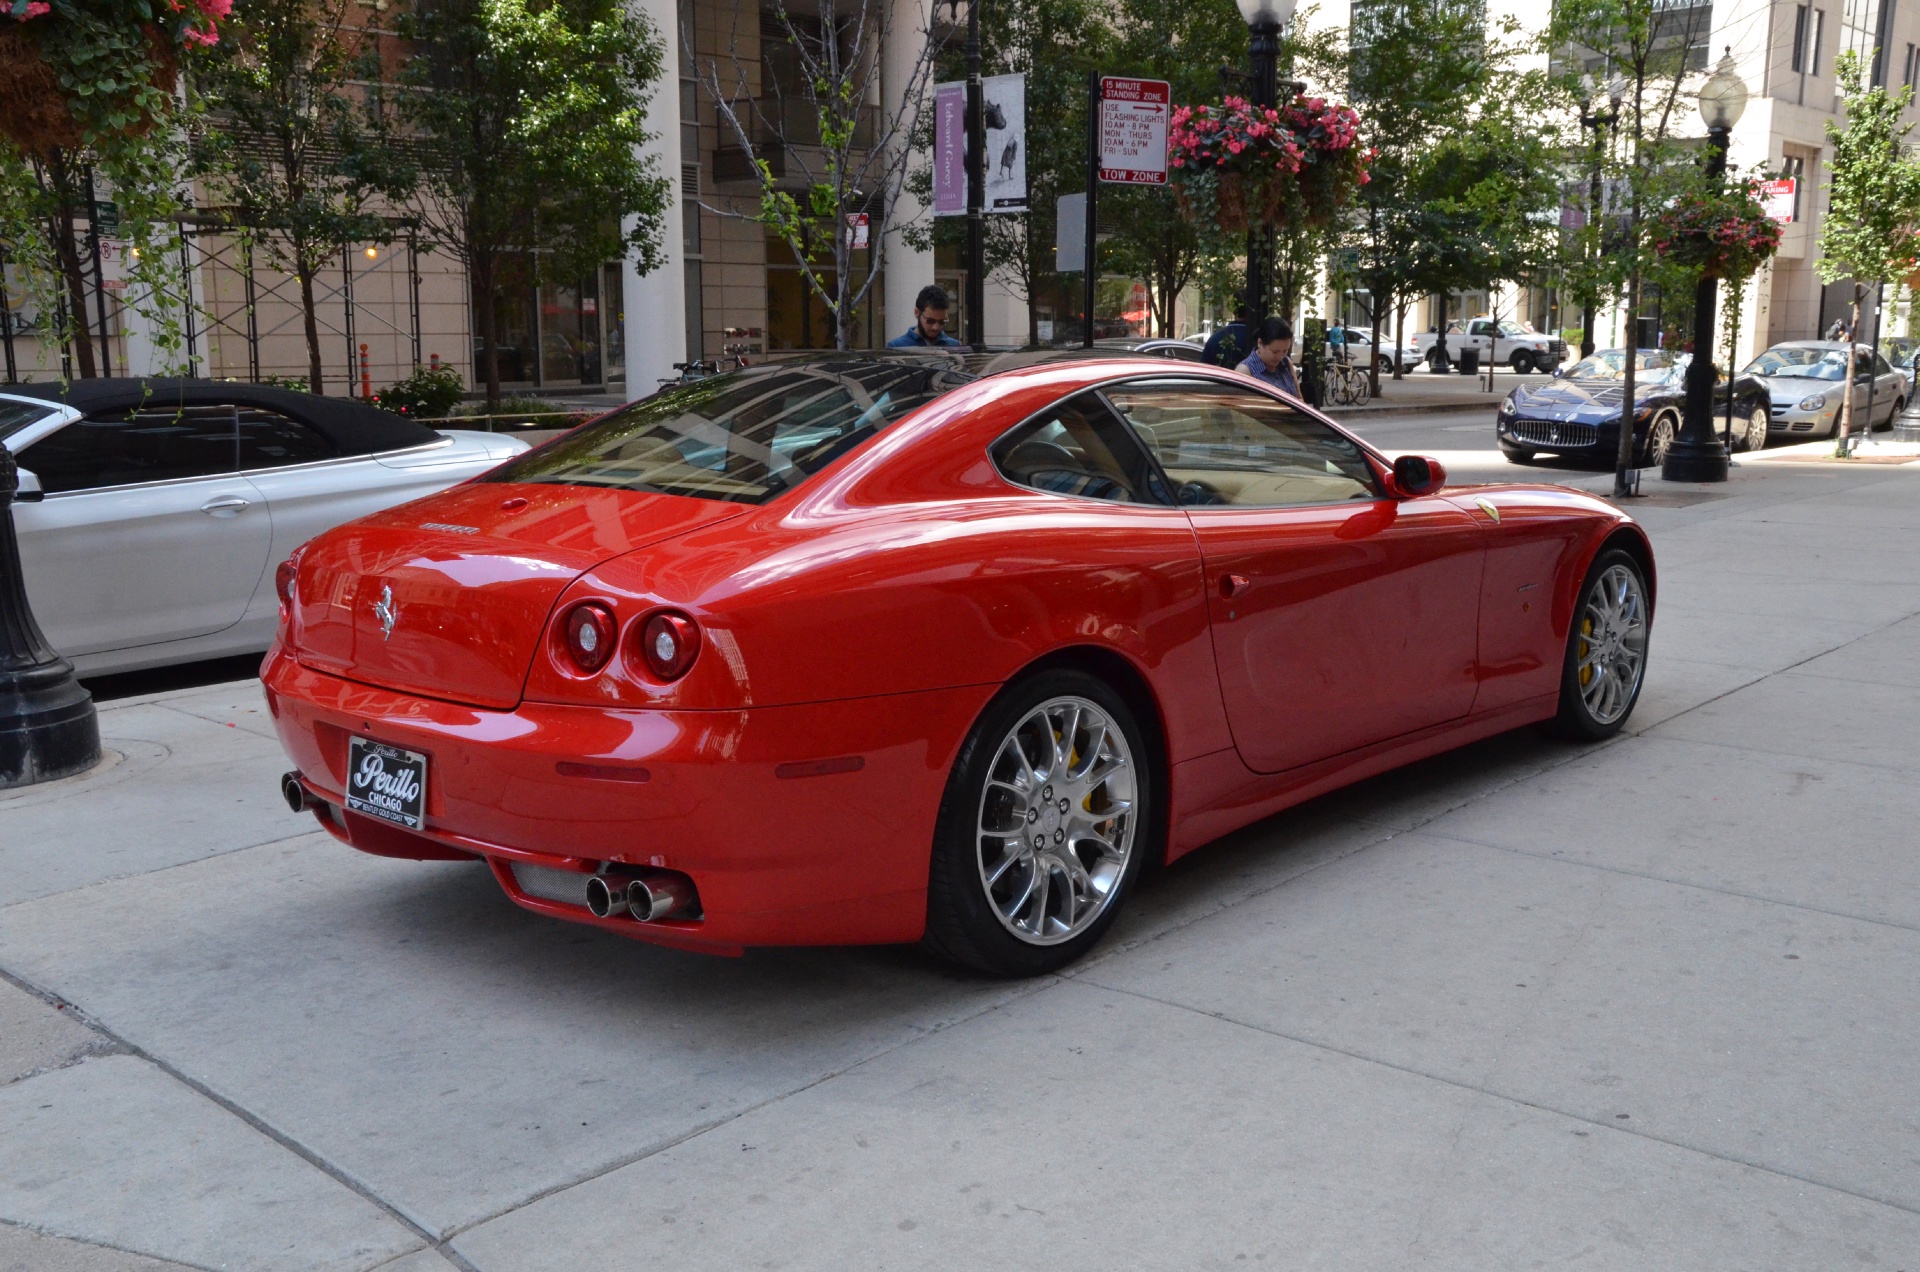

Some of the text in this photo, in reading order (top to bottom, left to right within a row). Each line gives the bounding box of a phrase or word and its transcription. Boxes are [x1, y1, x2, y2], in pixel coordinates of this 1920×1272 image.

[1115, 81, 1141, 91] MINUTE
[1106, 90, 1162, 101] STANDING ZONE
[1105, 104, 1119, 112] USE
[1105, 112, 1165, 123] FLASHING LIGHTS
[945, 102, 953, 149] Edward
[1129, 131, 1153, 140] THURS
[1104, 147, 1116, 155] FRI
[1122, 148, 1138, 156] SUN
[1104, 169, 1161, 182] TOW ZONE
[373, 744, 398, 757] Perillo
[354, 753, 419, 803] Perillo
[368, 791, 402, 812] CHICAGO
[362, 803, 403, 822] BENTLEY GOLD COAST
